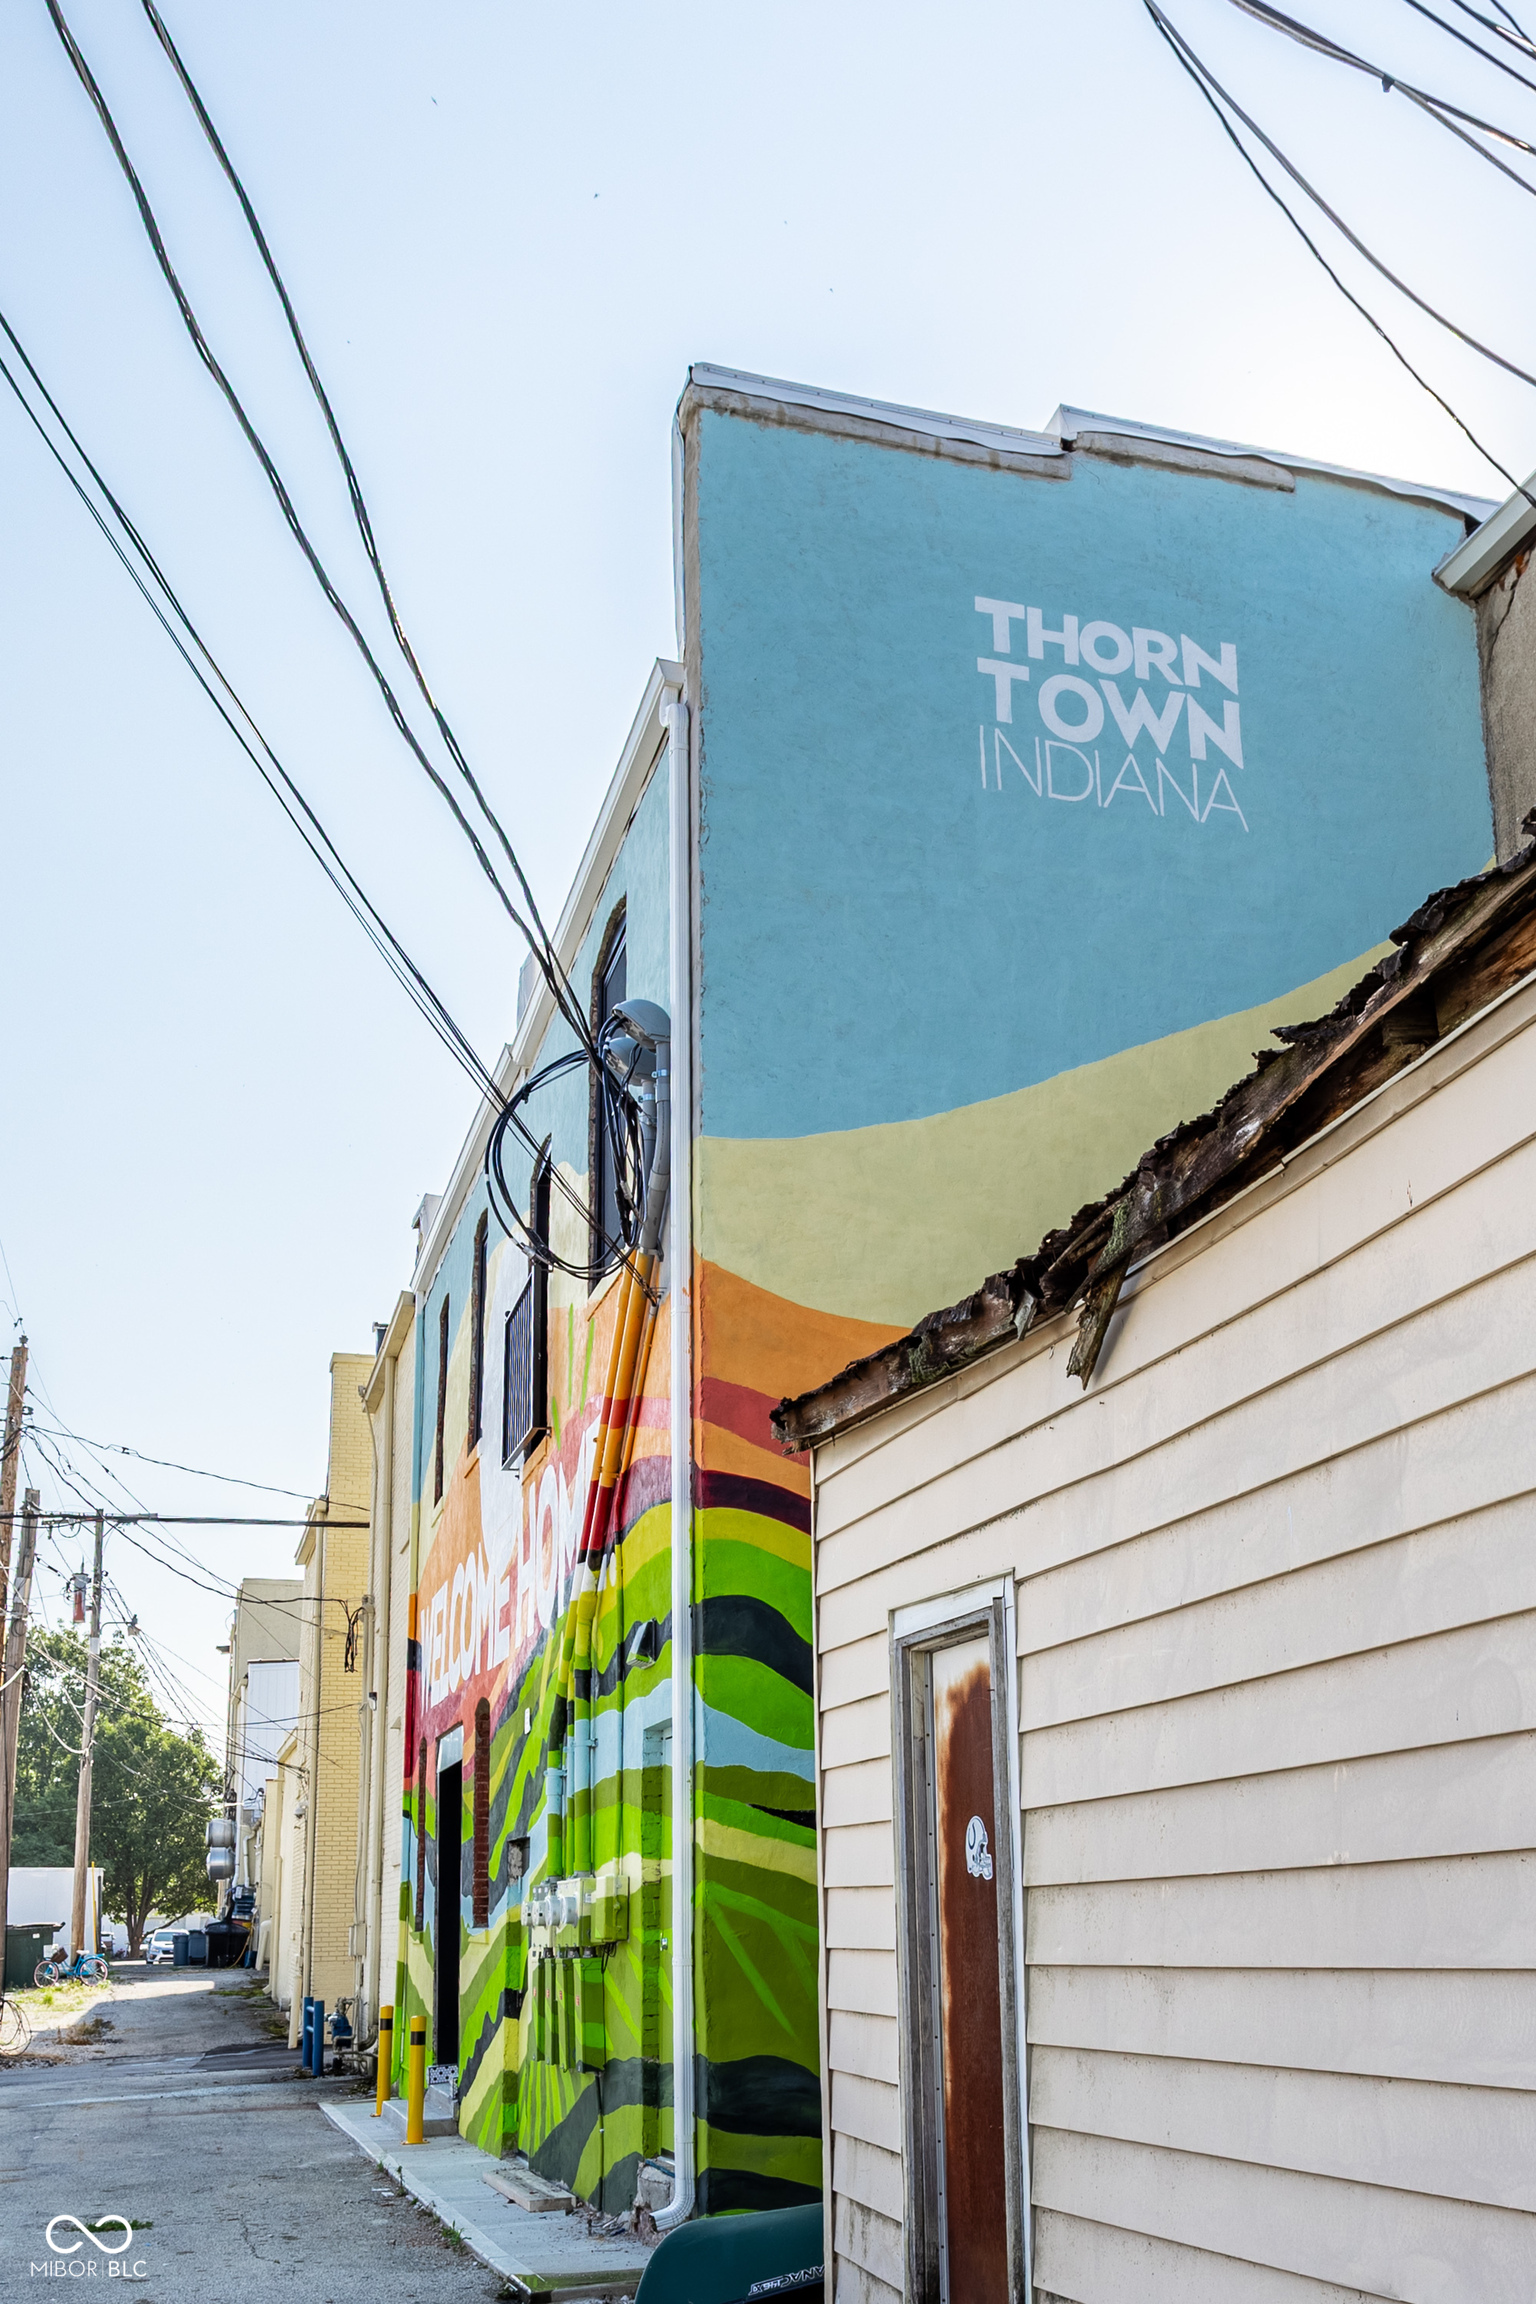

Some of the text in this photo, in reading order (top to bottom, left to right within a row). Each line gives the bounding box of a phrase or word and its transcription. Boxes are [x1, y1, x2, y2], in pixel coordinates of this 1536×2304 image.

[974, 595, 1239, 696] THORN
[977, 656, 1244, 770] TOWN
[979, 724, 1249, 833] INDIANA
[420, 1541, 510, 1717] WELCOME
